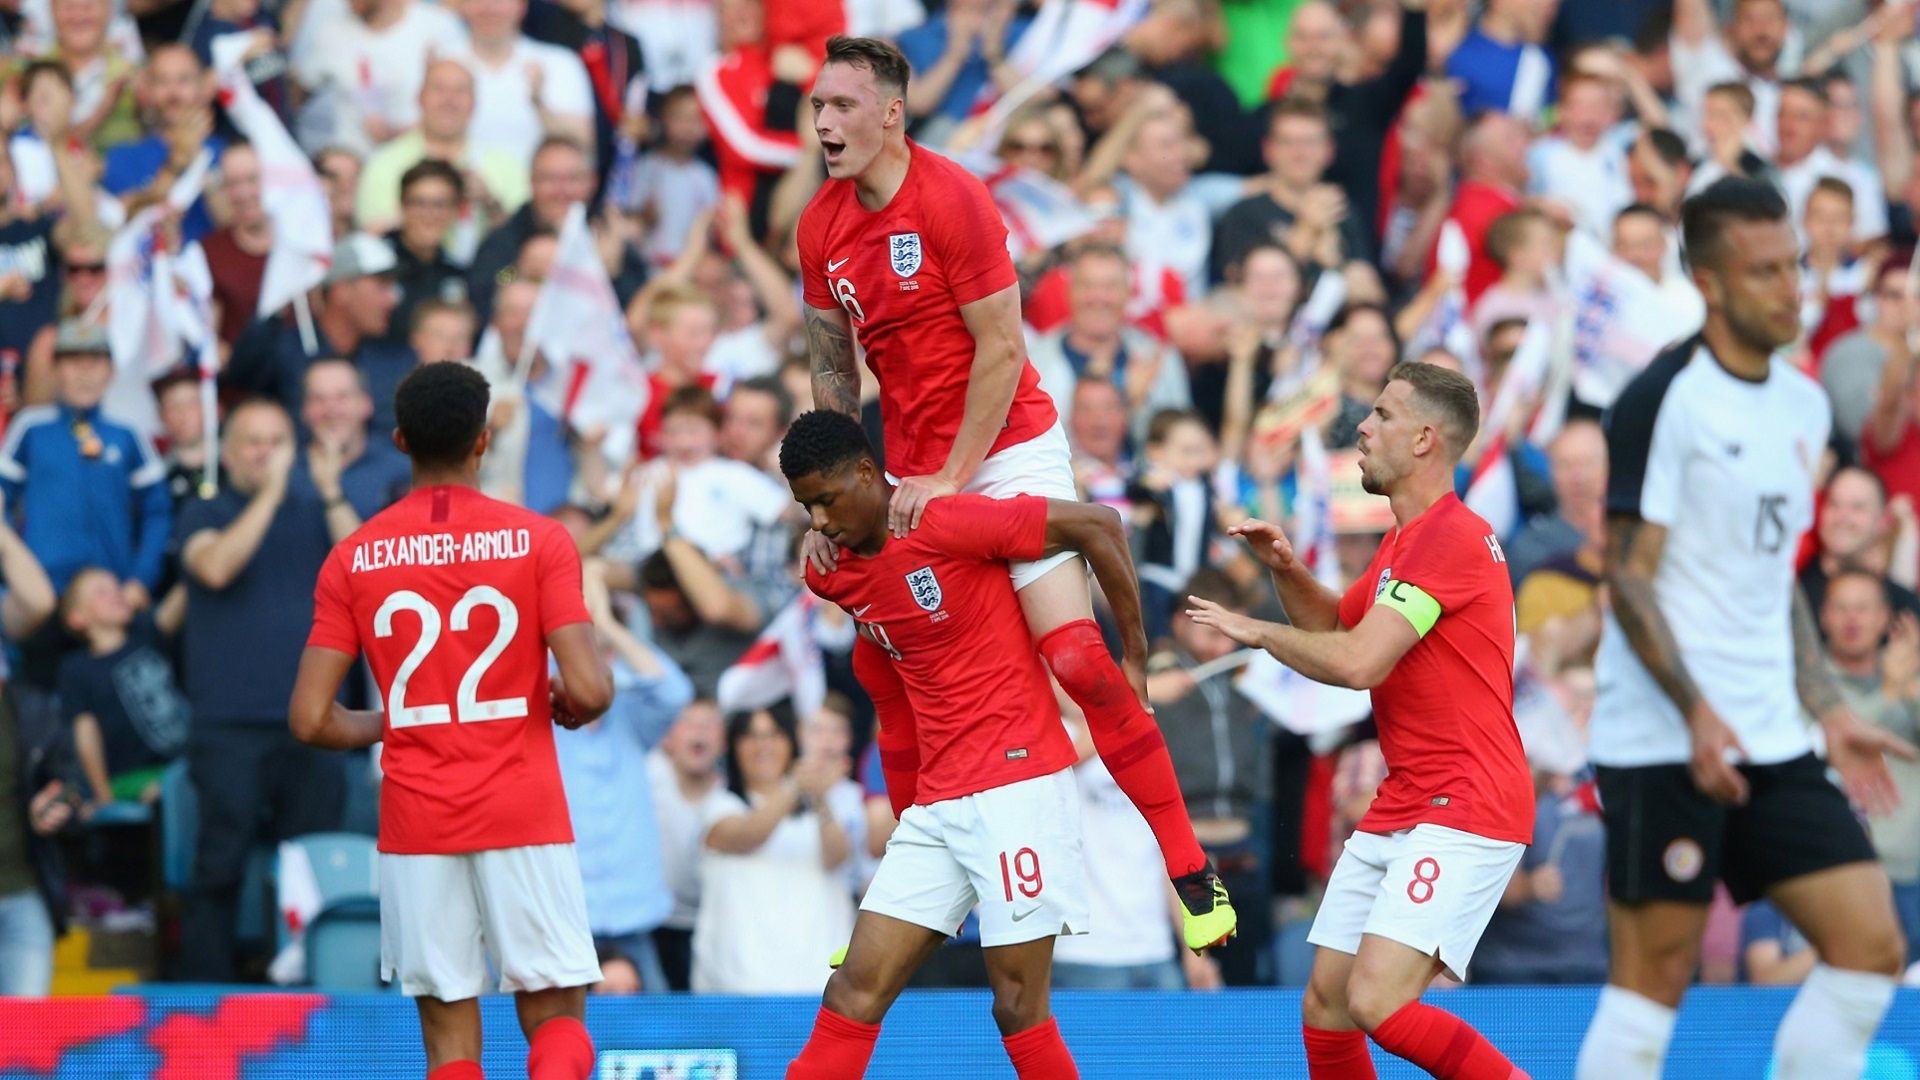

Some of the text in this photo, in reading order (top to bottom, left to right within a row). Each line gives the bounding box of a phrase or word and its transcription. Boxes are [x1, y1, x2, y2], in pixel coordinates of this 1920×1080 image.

[351, 528, 531, 573] ALEXANDER-ARNOLD
[1753, 493, 1788, 557] 15
[374, 585, 529, 729] 22
[999, 847, 1043, 902] 19
[1407, 857, 1440, 904] 8
